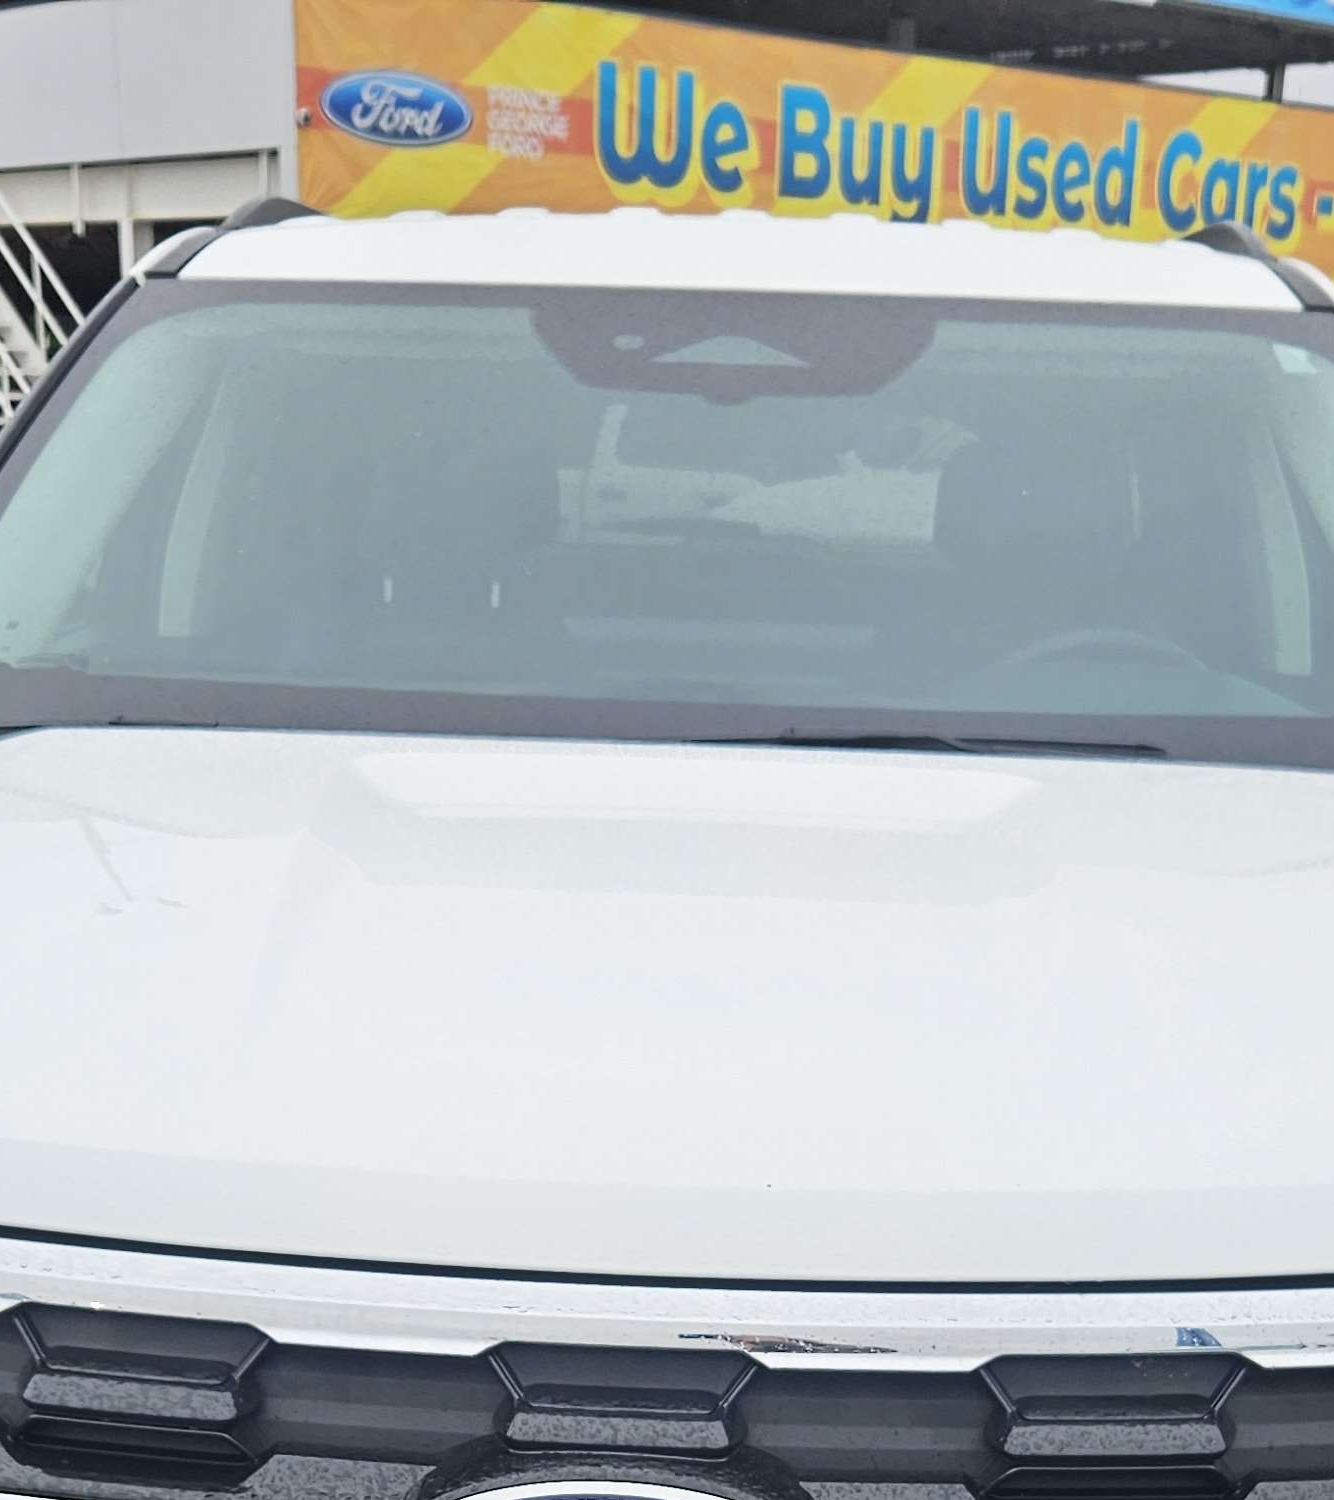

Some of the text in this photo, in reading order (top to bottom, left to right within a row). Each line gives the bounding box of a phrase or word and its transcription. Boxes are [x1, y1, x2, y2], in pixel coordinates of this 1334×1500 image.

[351, 80, 445, 137] Ford
[486, 84, 561, 113] PRINCE
[486, 109, 570, 141] GEORGE
[486, 132, 544, 160] FORD
[597, 60, 750, 193] We
[777, 83, 936, 224] Buy
[965, 106, 1140, 228] Used
[1157, 129, 1299, 240] Cars
